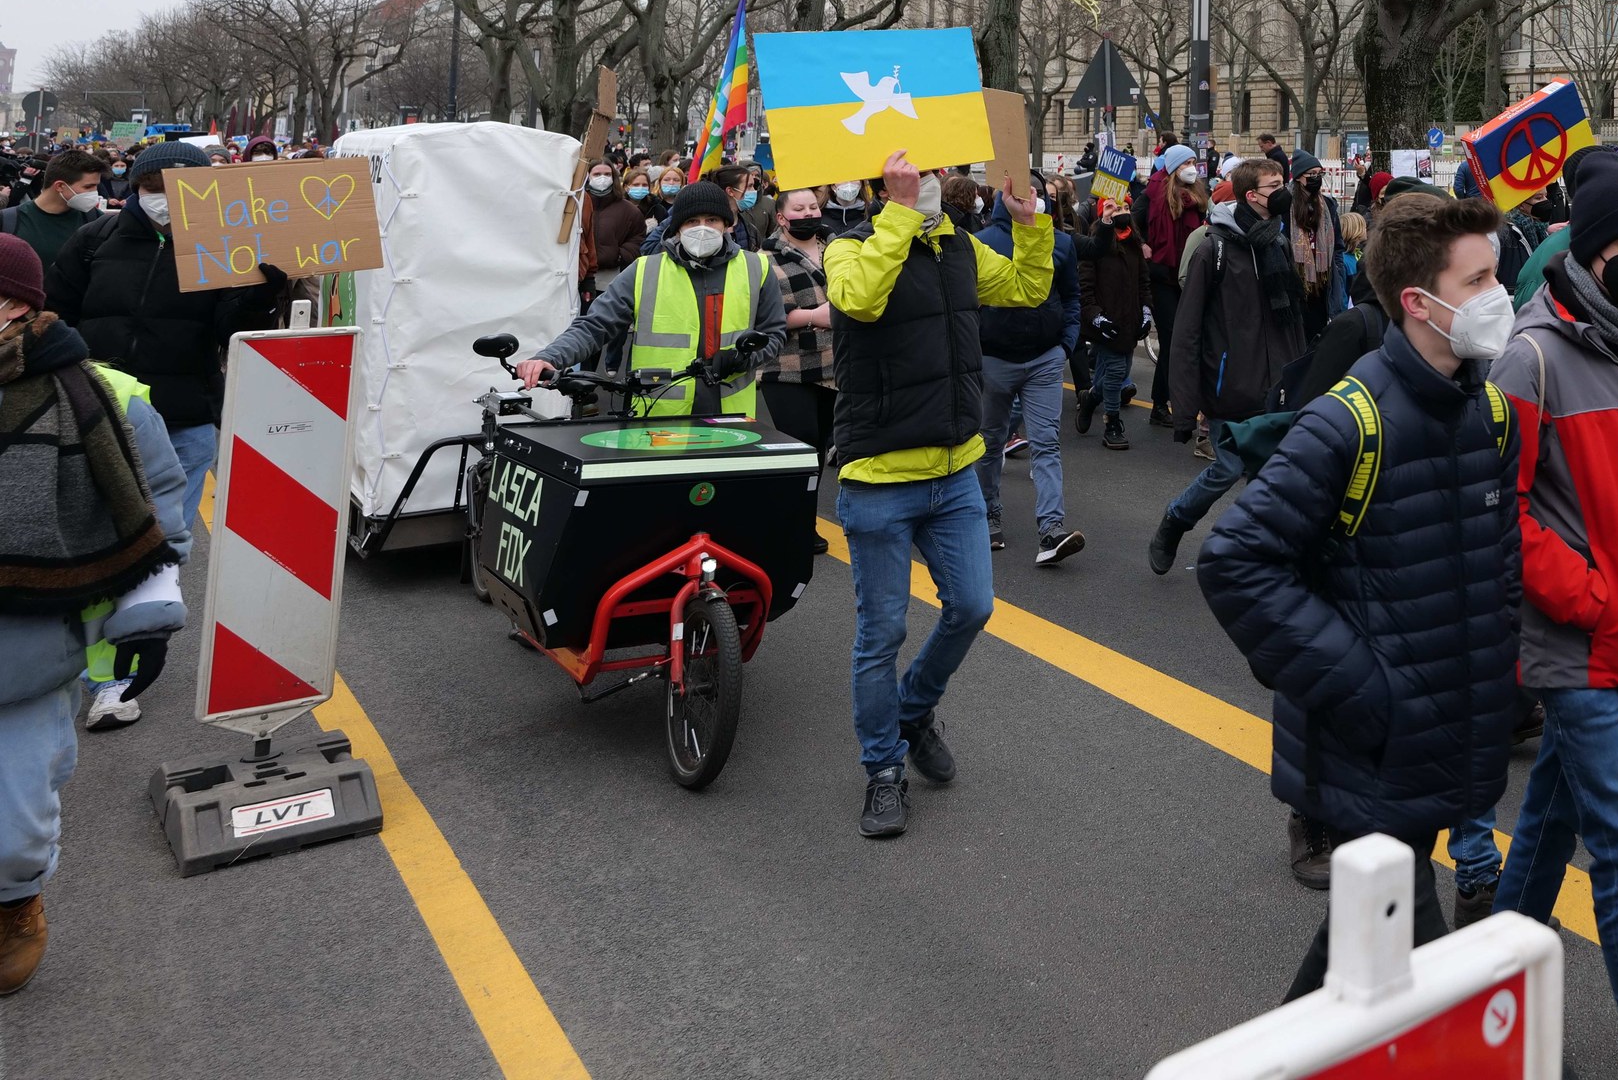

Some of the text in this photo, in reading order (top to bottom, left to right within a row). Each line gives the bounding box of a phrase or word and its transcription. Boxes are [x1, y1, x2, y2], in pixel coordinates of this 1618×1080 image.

[1100, 149, 1126, 176] NICHT
[177, 177, 289, 230] Make
[295, 237, 361, 268] war
[268, 425, 290, 434] LVT
[1346, 391, 1377, 435] PUMA
[488, 457, 544, 527] LASCA
[1347, 451, 1376, 501] PUMA
[495, 521, 533, 588] FOX
[254, 799, 311, 827] LVT
